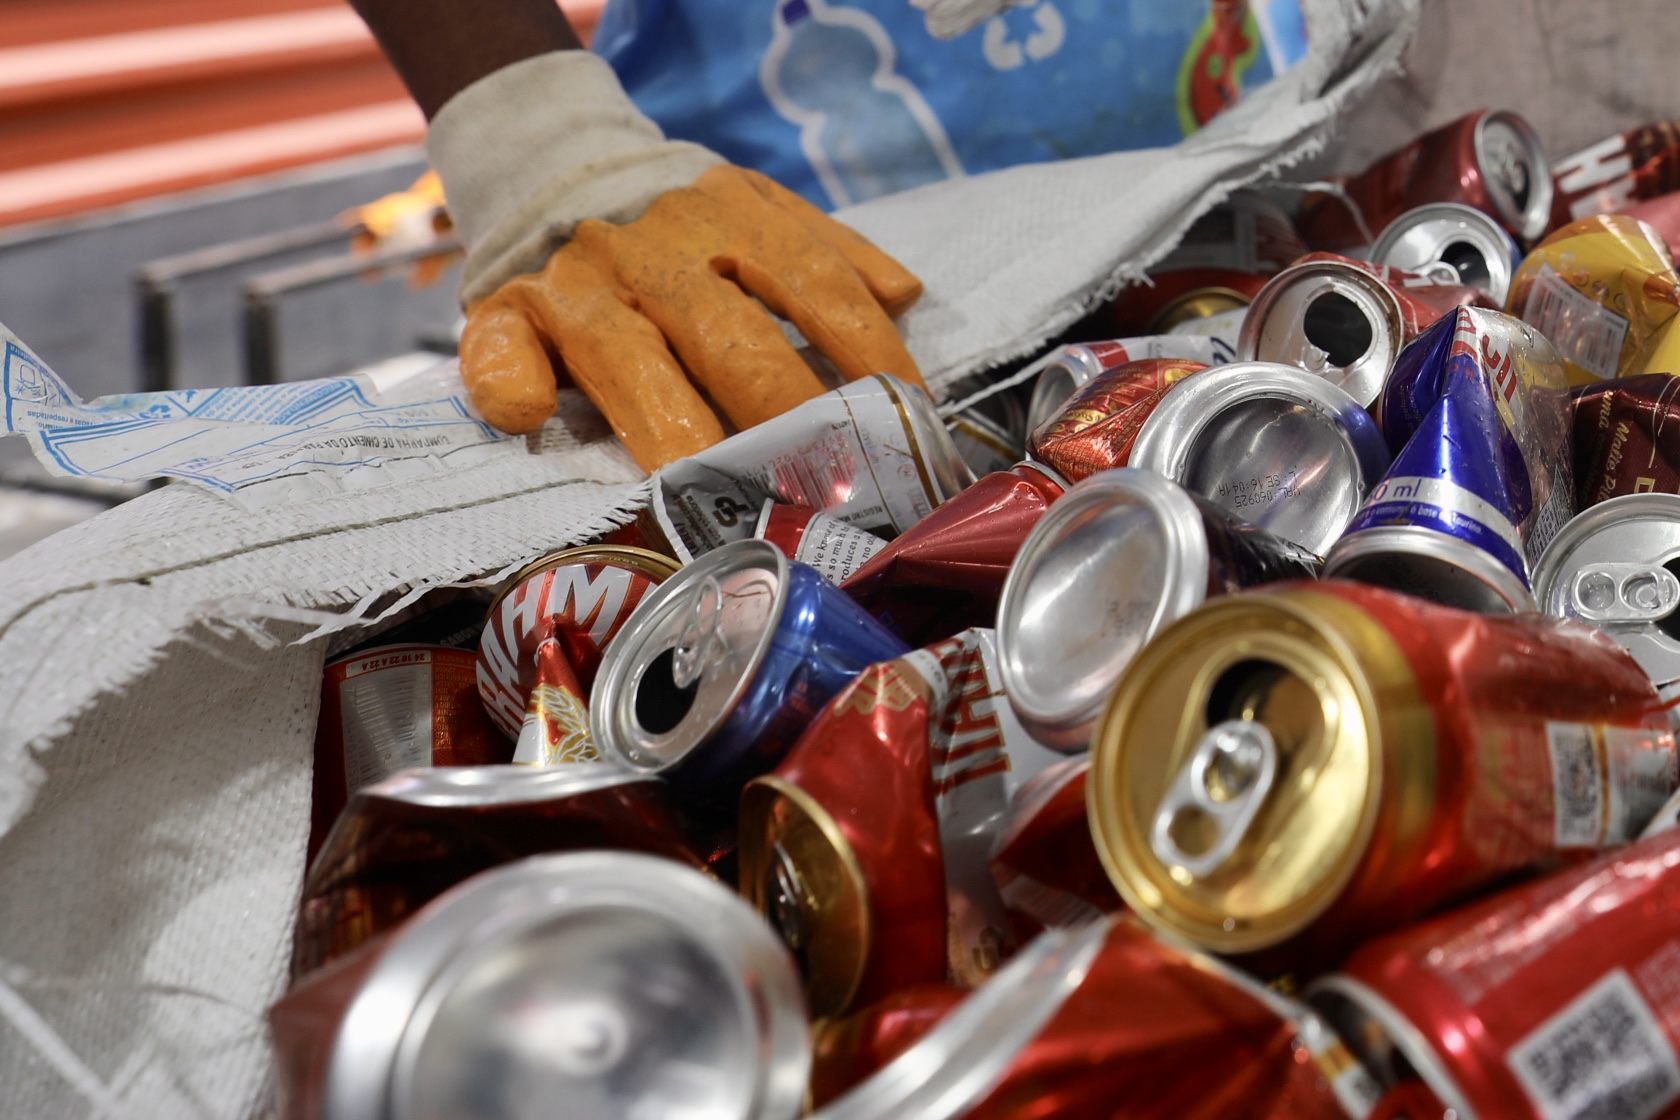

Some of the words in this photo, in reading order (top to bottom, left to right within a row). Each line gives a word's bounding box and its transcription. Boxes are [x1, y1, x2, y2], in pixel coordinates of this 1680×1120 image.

[27, 410, 69, 421] respeitadas
[1605, 421, 1630, 473] Malte
[1393, 478, 1422, 498] ml
[1418, 504, 1438, 518] base
[841, 541, 858, 582] roduces
